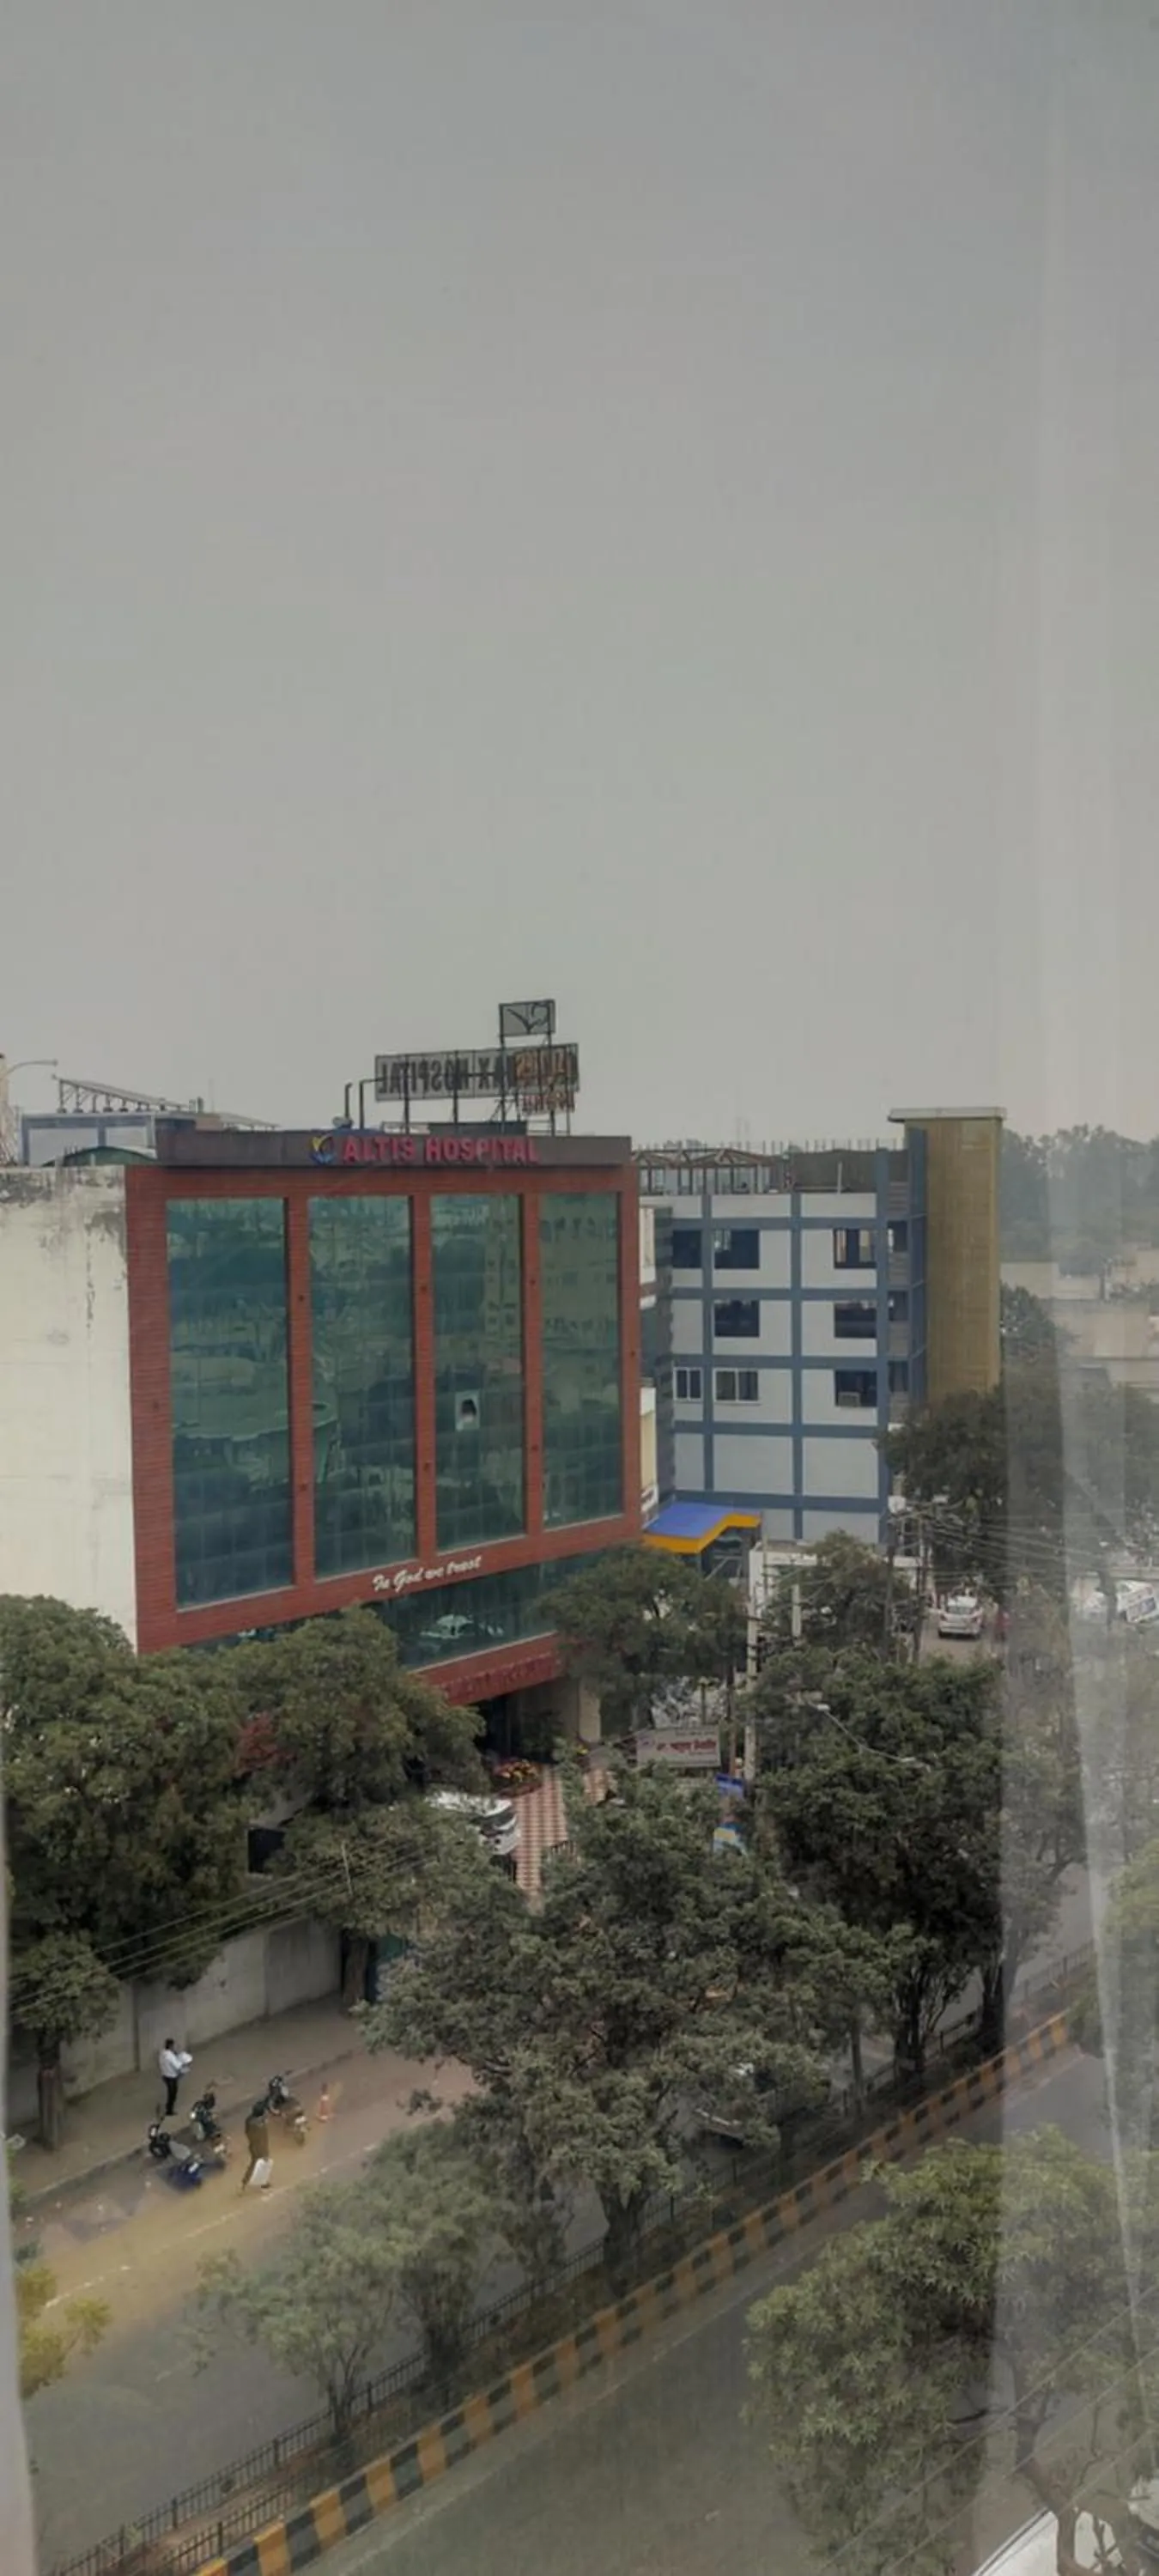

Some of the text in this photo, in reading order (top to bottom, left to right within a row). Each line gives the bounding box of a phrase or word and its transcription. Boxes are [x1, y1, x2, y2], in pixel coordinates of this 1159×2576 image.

[344, 1136, 539, 1163] ALTIS HOSPITAL
[373, 1556, 482, 1592] In God we trust
